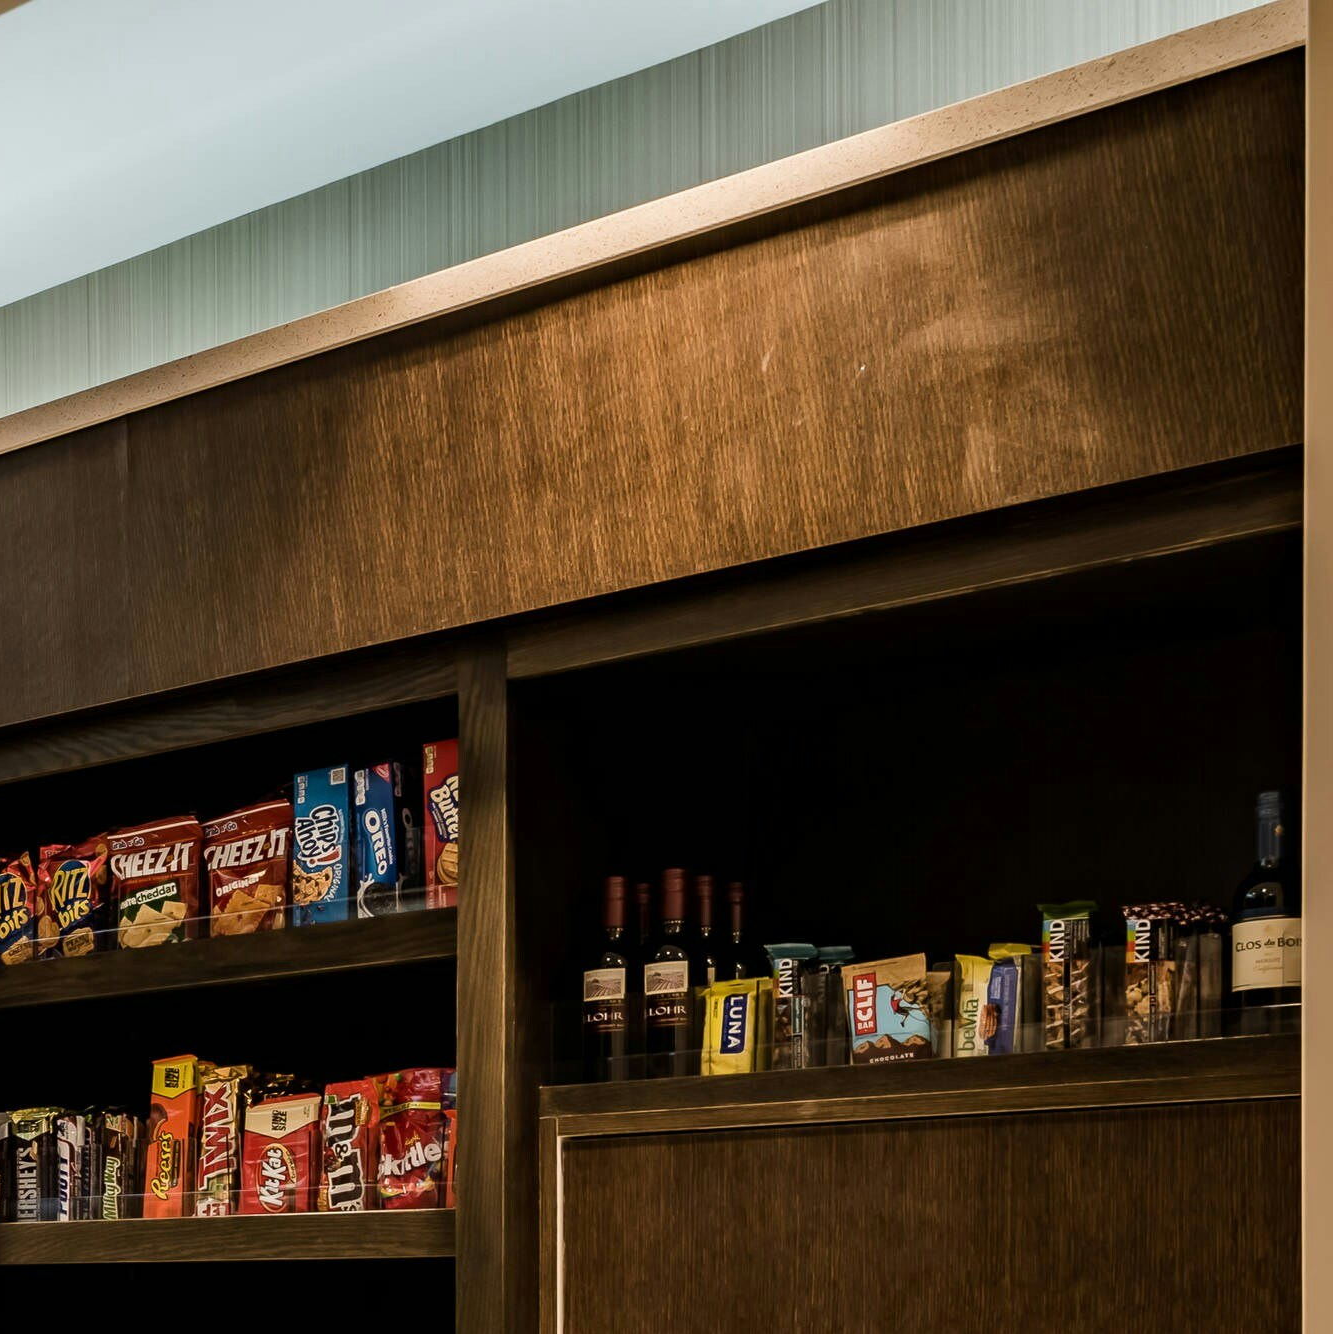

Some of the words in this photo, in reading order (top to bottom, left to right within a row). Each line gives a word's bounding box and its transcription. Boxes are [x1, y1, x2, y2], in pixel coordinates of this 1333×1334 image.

[310, 804, 339, 854] Chips
[364, 810, 388, 876] OREO
[49, 861, 91, 911] RITZ
[136, 882, 177, 905] cheddar
[324, 863, 343, 903] ORIGINAL
[58, 898, 91, 929] bits
[1049, 919, 1065, 963] KIND
[1134, 919, 1151, 963] KIND
[1235, 938, 1262, 953] CLOS
[1277, 936, 1302, 948] BOI
[779, 958, 793, 999] KIND
[856, 977, 875, 1023] CLIF
[726, 995, 745, 1049] LUNA
[857, 1020, 875, 1031] BAR
[172, 1067, 180, 1089] SIZE
[869, 1051, 915, 1064] CHOCOLATE
[198, 1083, 234, 1190] TWIX
[279, 1109, 287, 1131] SIZE
[151, 1130, 174, 1201] Reese's
